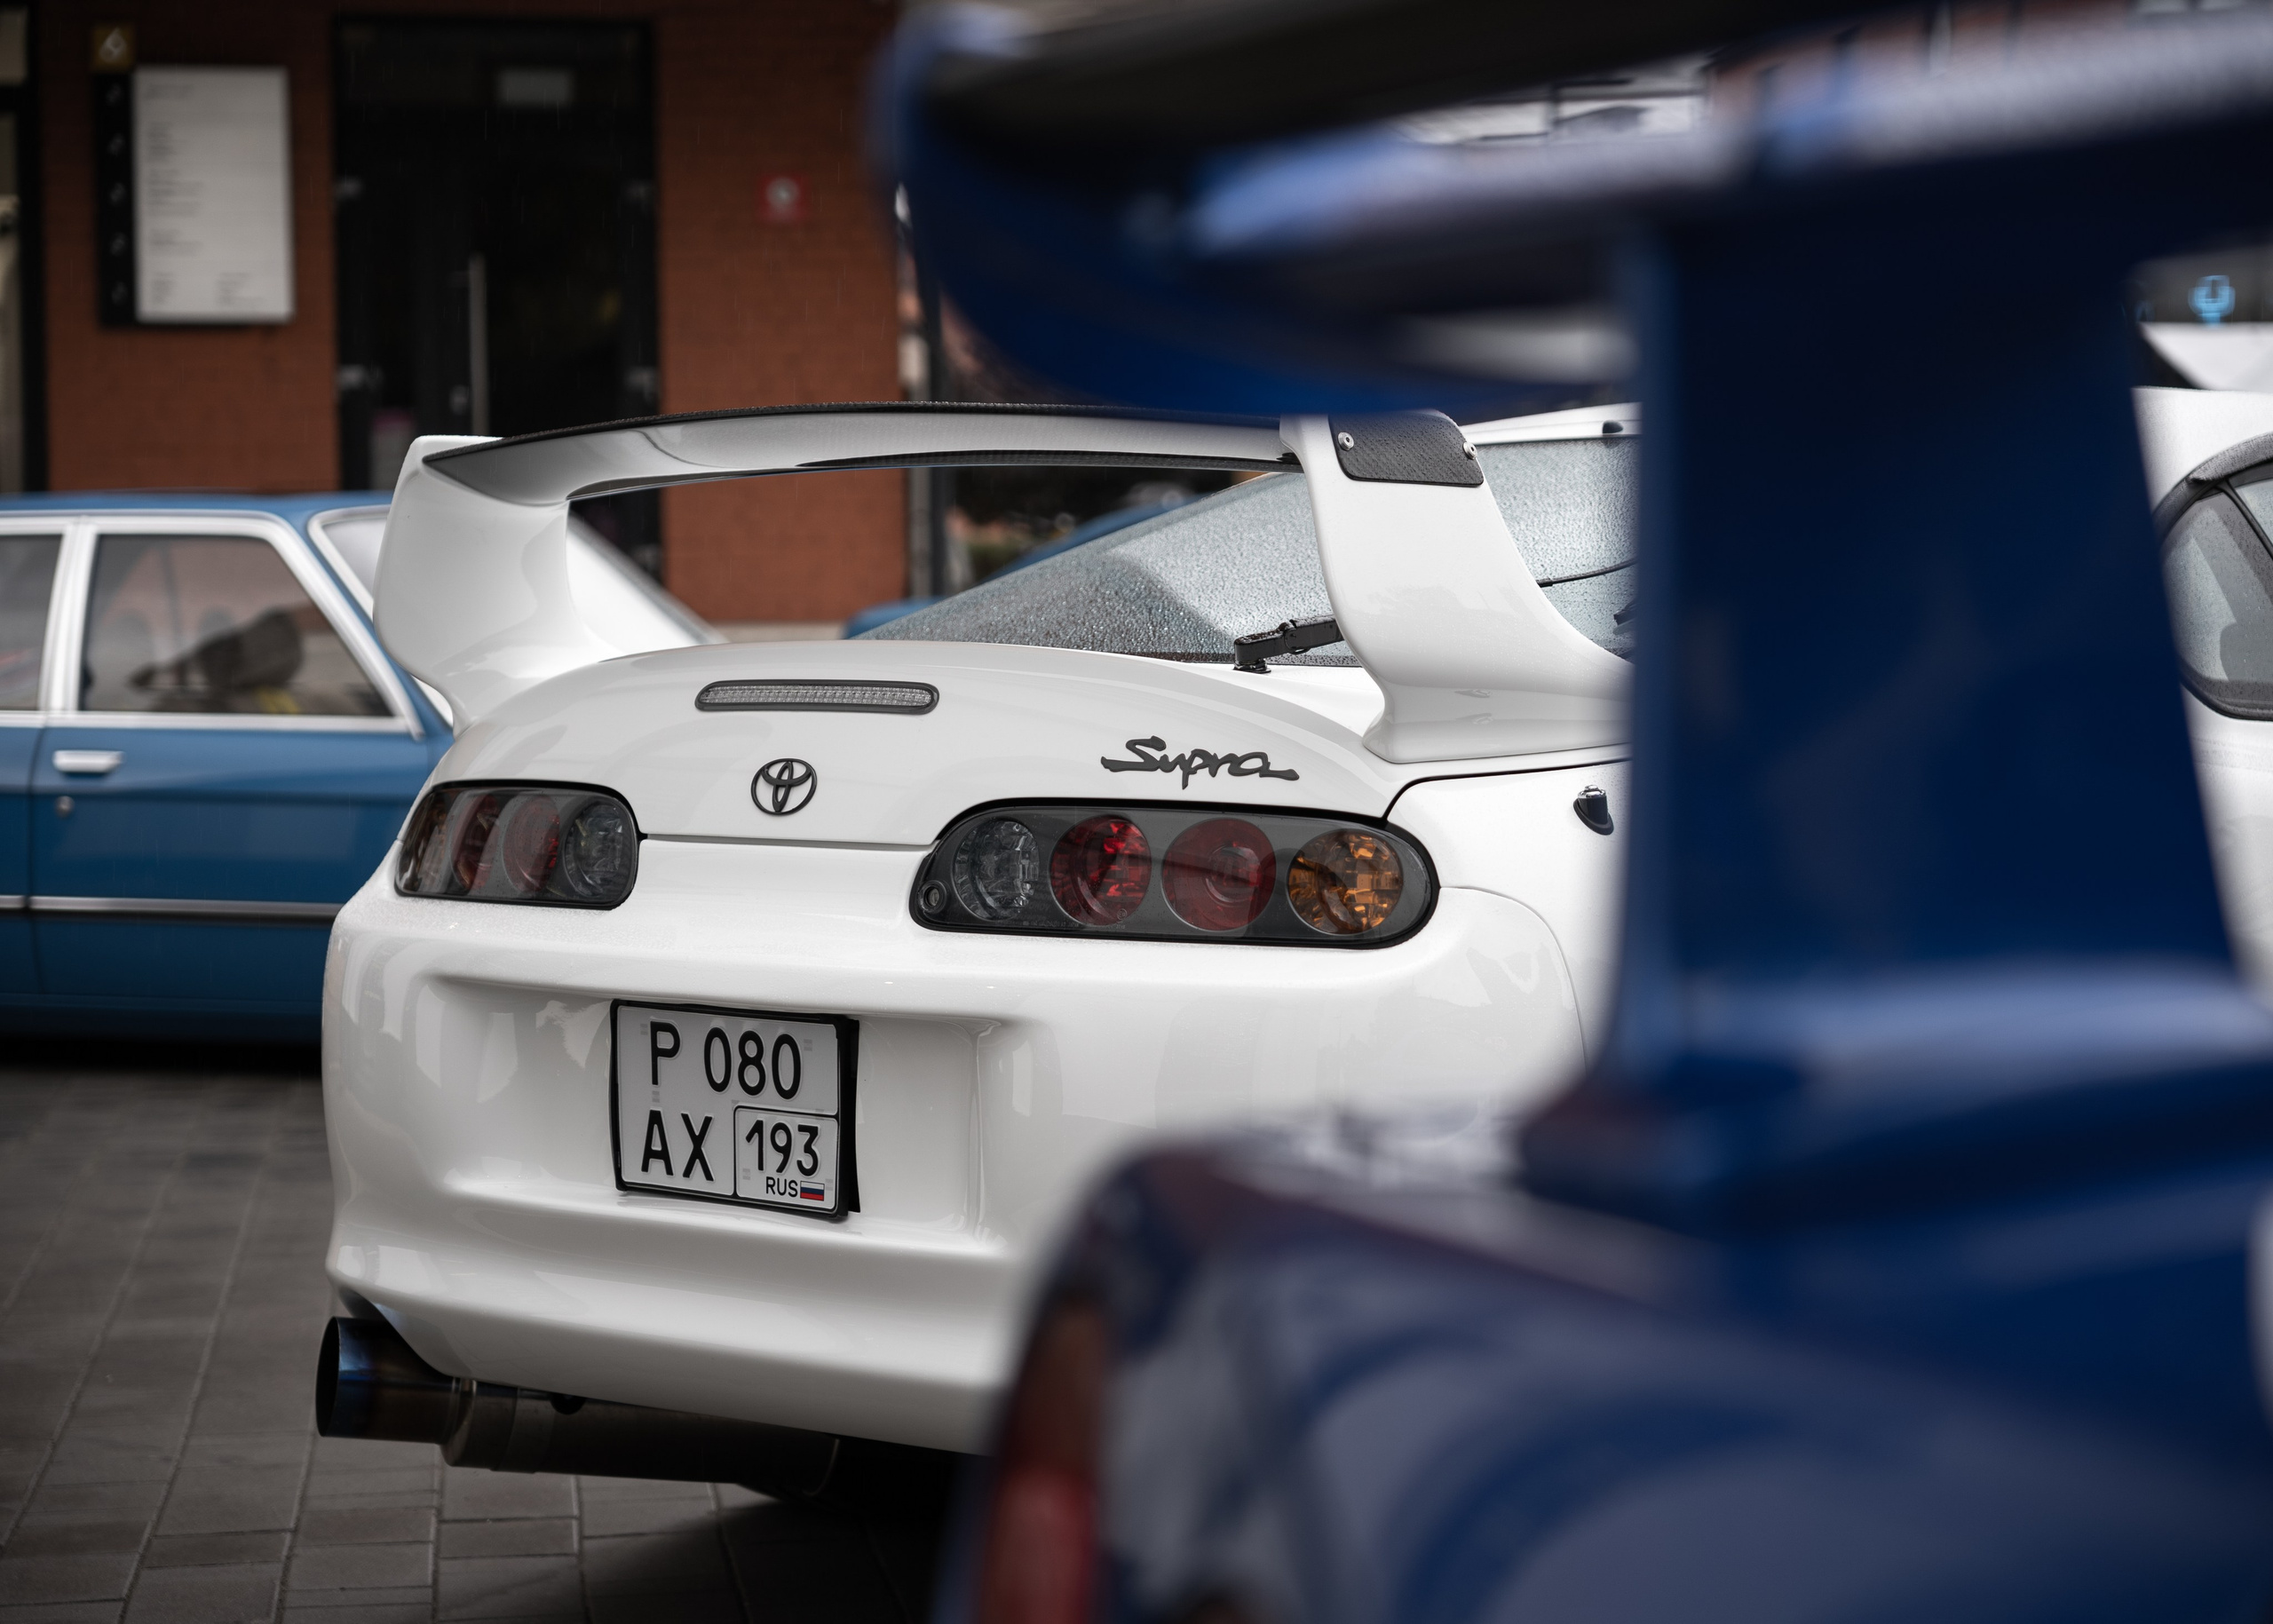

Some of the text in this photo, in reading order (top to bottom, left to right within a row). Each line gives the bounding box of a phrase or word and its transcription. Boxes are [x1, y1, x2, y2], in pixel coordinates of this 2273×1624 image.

[1100, 735, 1300, 790] Supra
[650, 1020, 801, 1100] P 080
[641, 1109, 715, 1182] AX
[745, 1119, 820, 1176] 193
[765, 1176, 798, 1198] RUS
